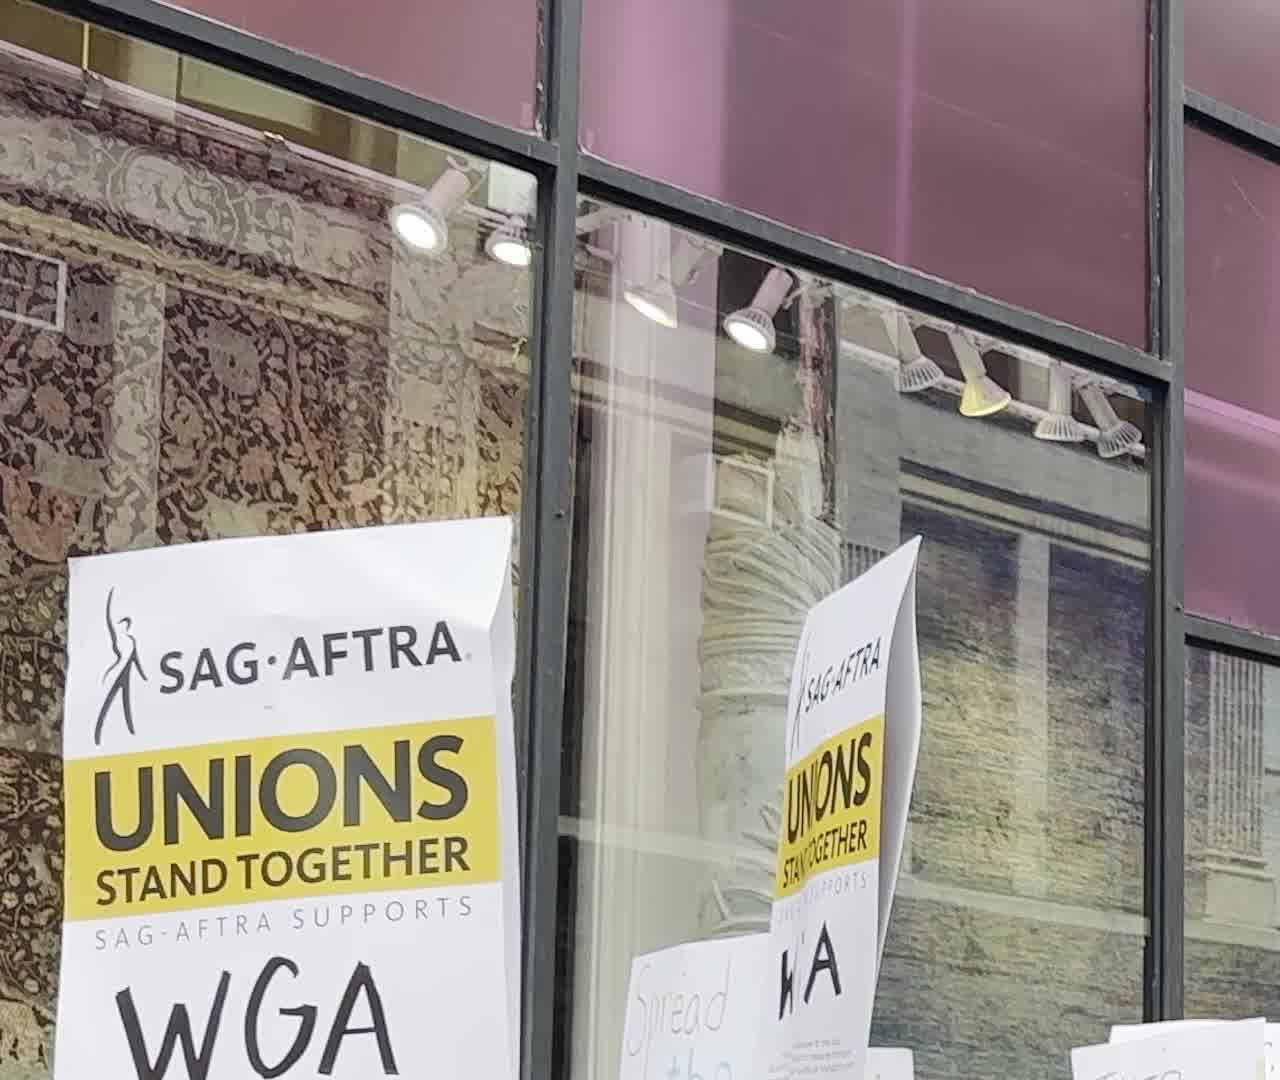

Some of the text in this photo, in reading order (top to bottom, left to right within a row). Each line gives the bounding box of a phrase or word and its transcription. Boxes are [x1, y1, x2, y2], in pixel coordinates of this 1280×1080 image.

[94, 735, 470, 852] UNIONS
[787, 731, 873, 845] UNONS
[95, 837, 471, 905] STAND TOGETHER
[94, 896, 474, 950] SAG-AFTRA SUPPORTS
